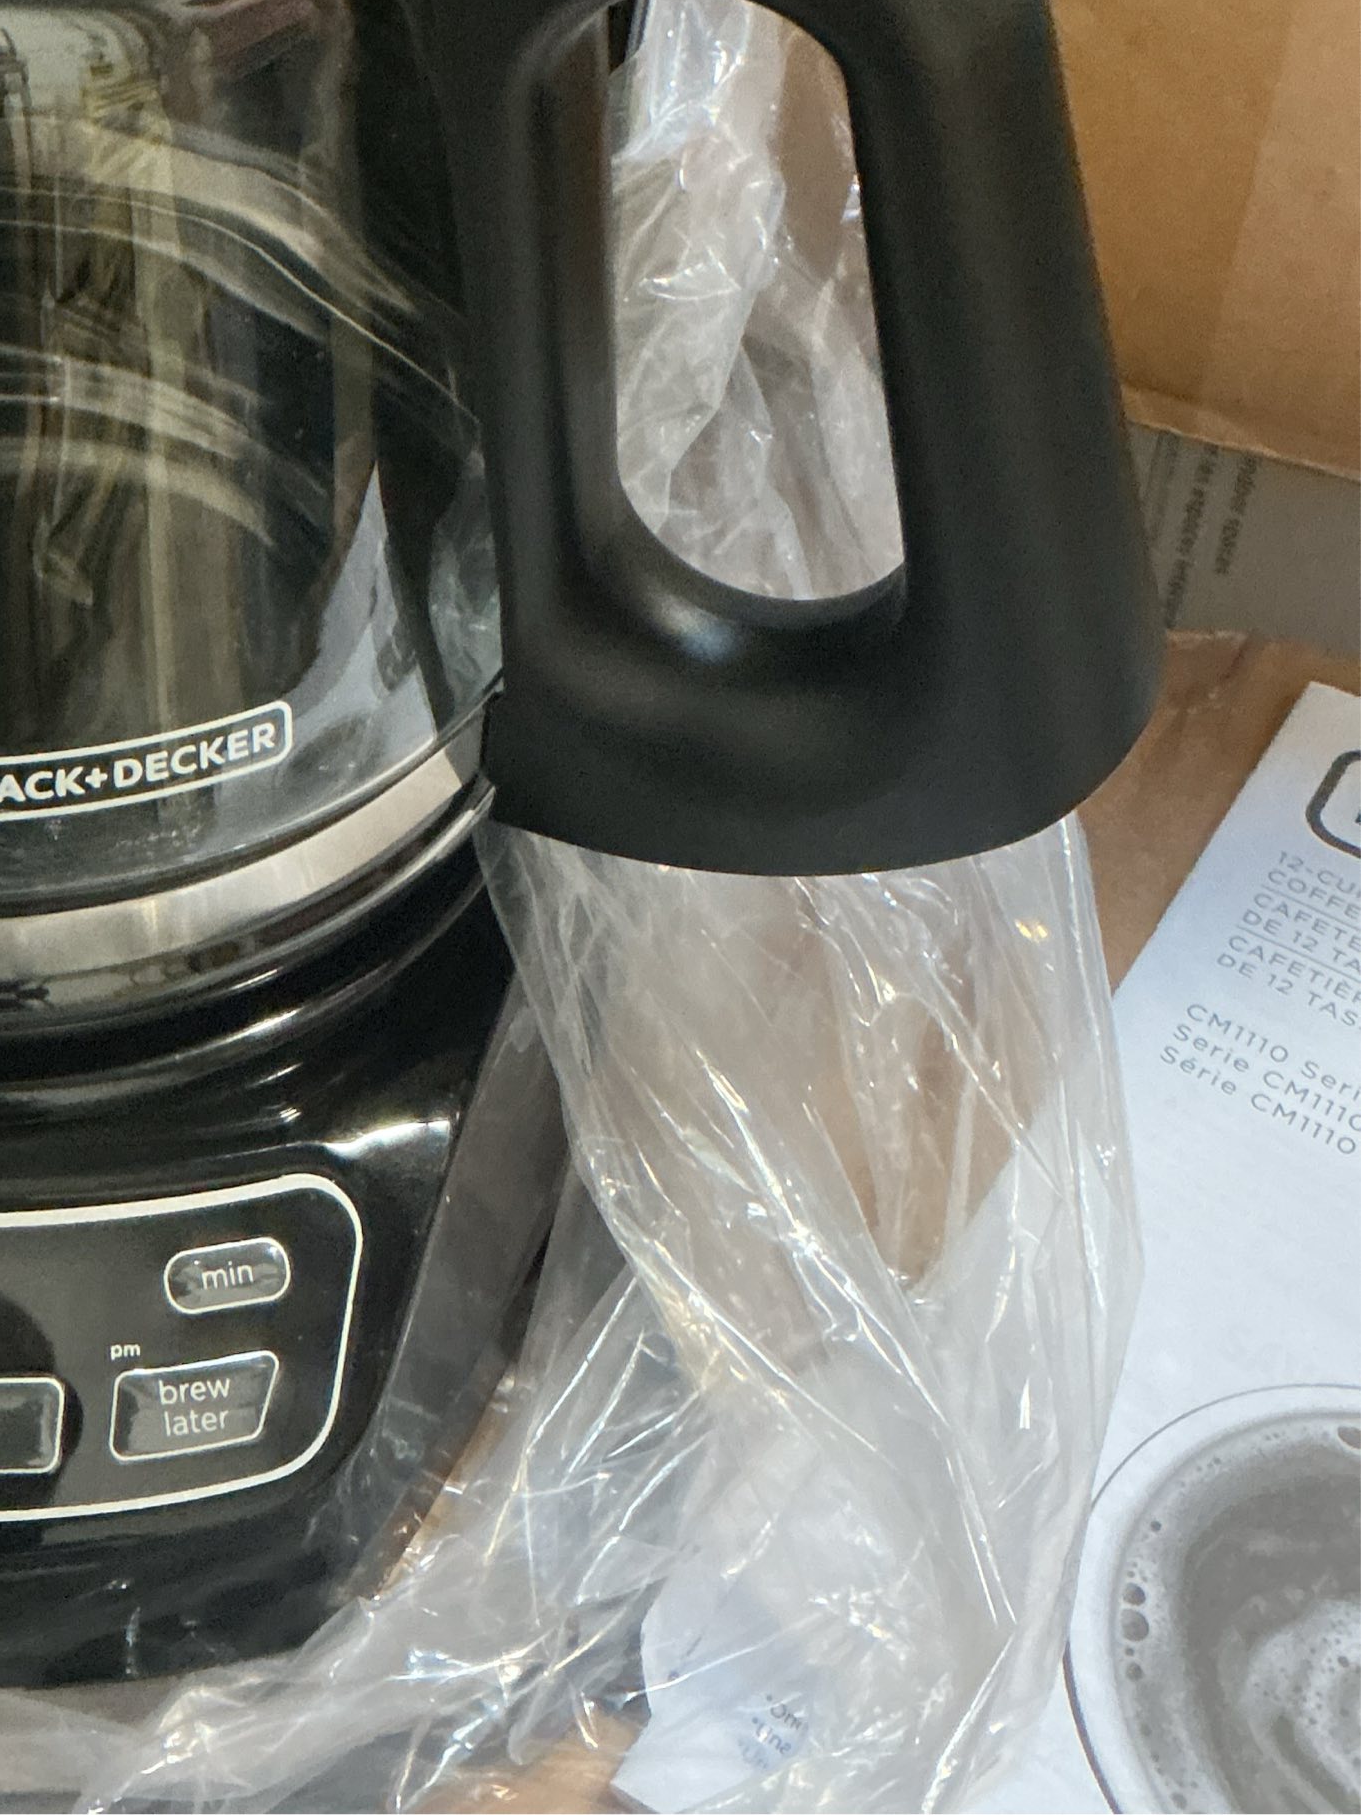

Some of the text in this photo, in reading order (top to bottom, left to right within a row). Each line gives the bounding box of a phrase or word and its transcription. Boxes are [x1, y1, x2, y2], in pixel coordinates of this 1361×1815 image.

[1278, 850, 1361, 898] 12-CU
[1242, 909, 1282, 935] DE
[1292, 931, 1319, 953] 12
[1216, 953, 1256, 979] DE
[1267, 973, 1294, 995] 12
[1172, 1024, 1250, 1073] Serie
[1186, 1004, 1289, 1063] CM1110
[1160, 1046, 1357, 1155] Série CM1110
[201, 1260, 255, 1290] min
[110, 1342, 141, 1362] pm
[158, 1376, 232, 1406] brew
[164, 1407, 230, 1437] later
